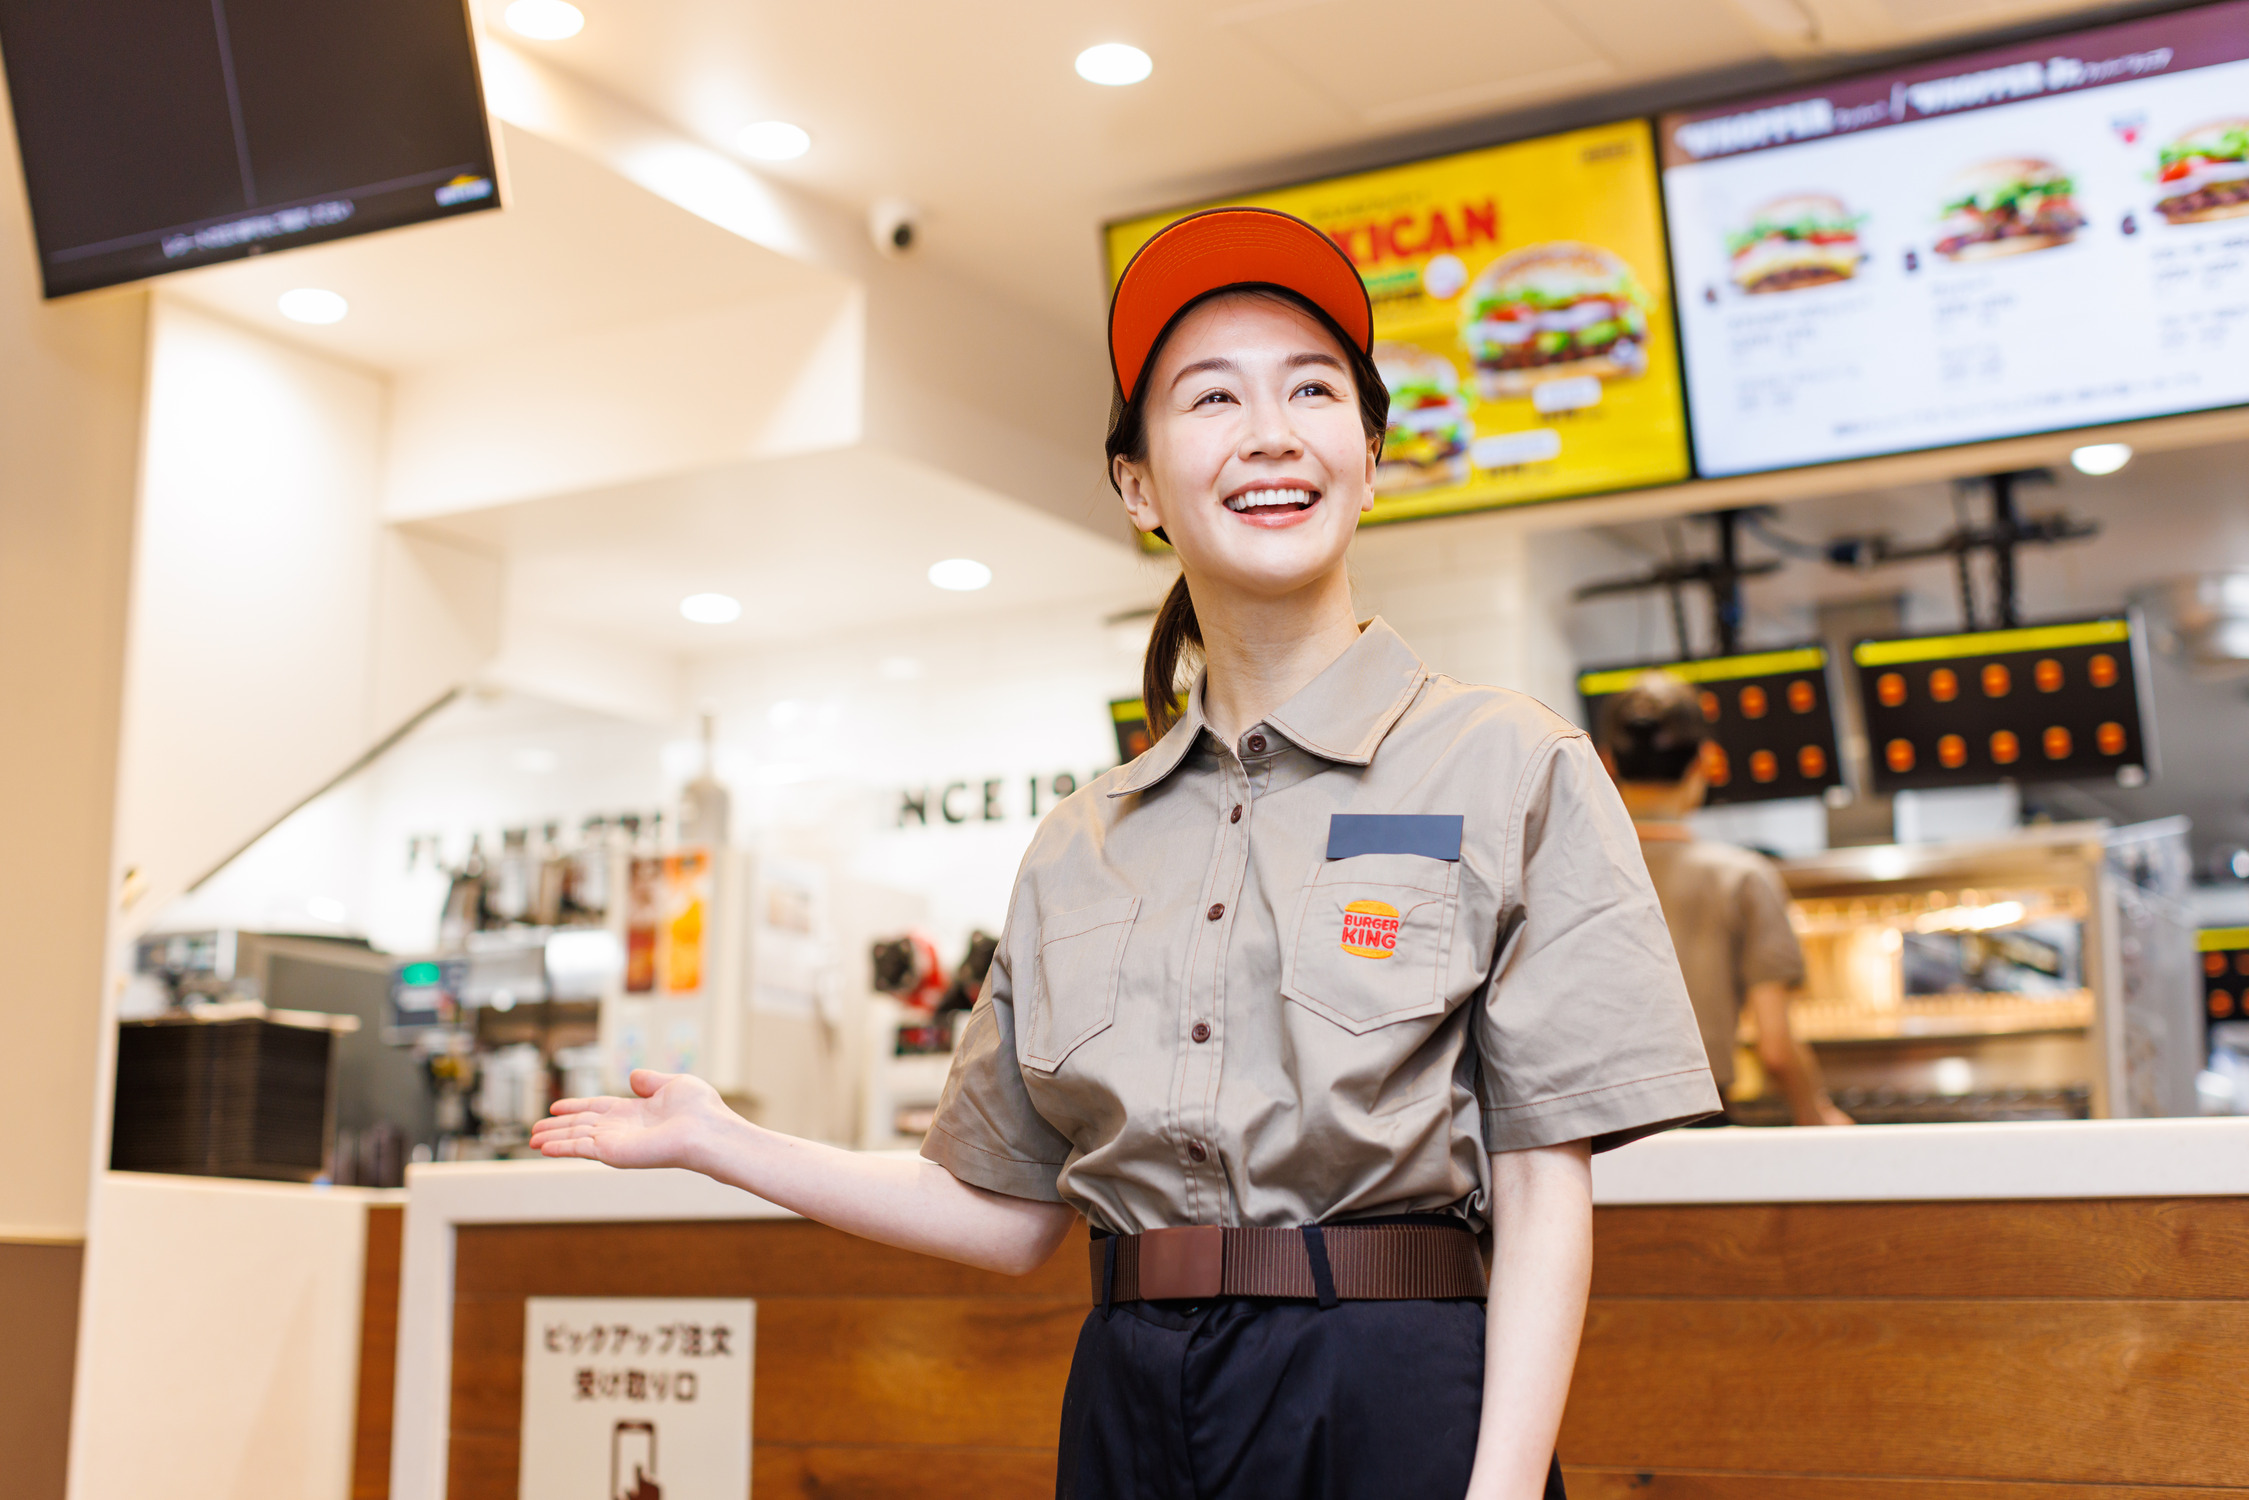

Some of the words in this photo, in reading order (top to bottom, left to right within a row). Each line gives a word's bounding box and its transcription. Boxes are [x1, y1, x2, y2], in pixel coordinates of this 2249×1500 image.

[1029, 767, 1110, 818] 19
[1341, 927, 1396, 949] KING
[1344, 914, 1399, 933] BURGER
[544, 1322, 734, 1358] ピックアップ注文
[573, 1368, 698, 1402] 受け取り口
